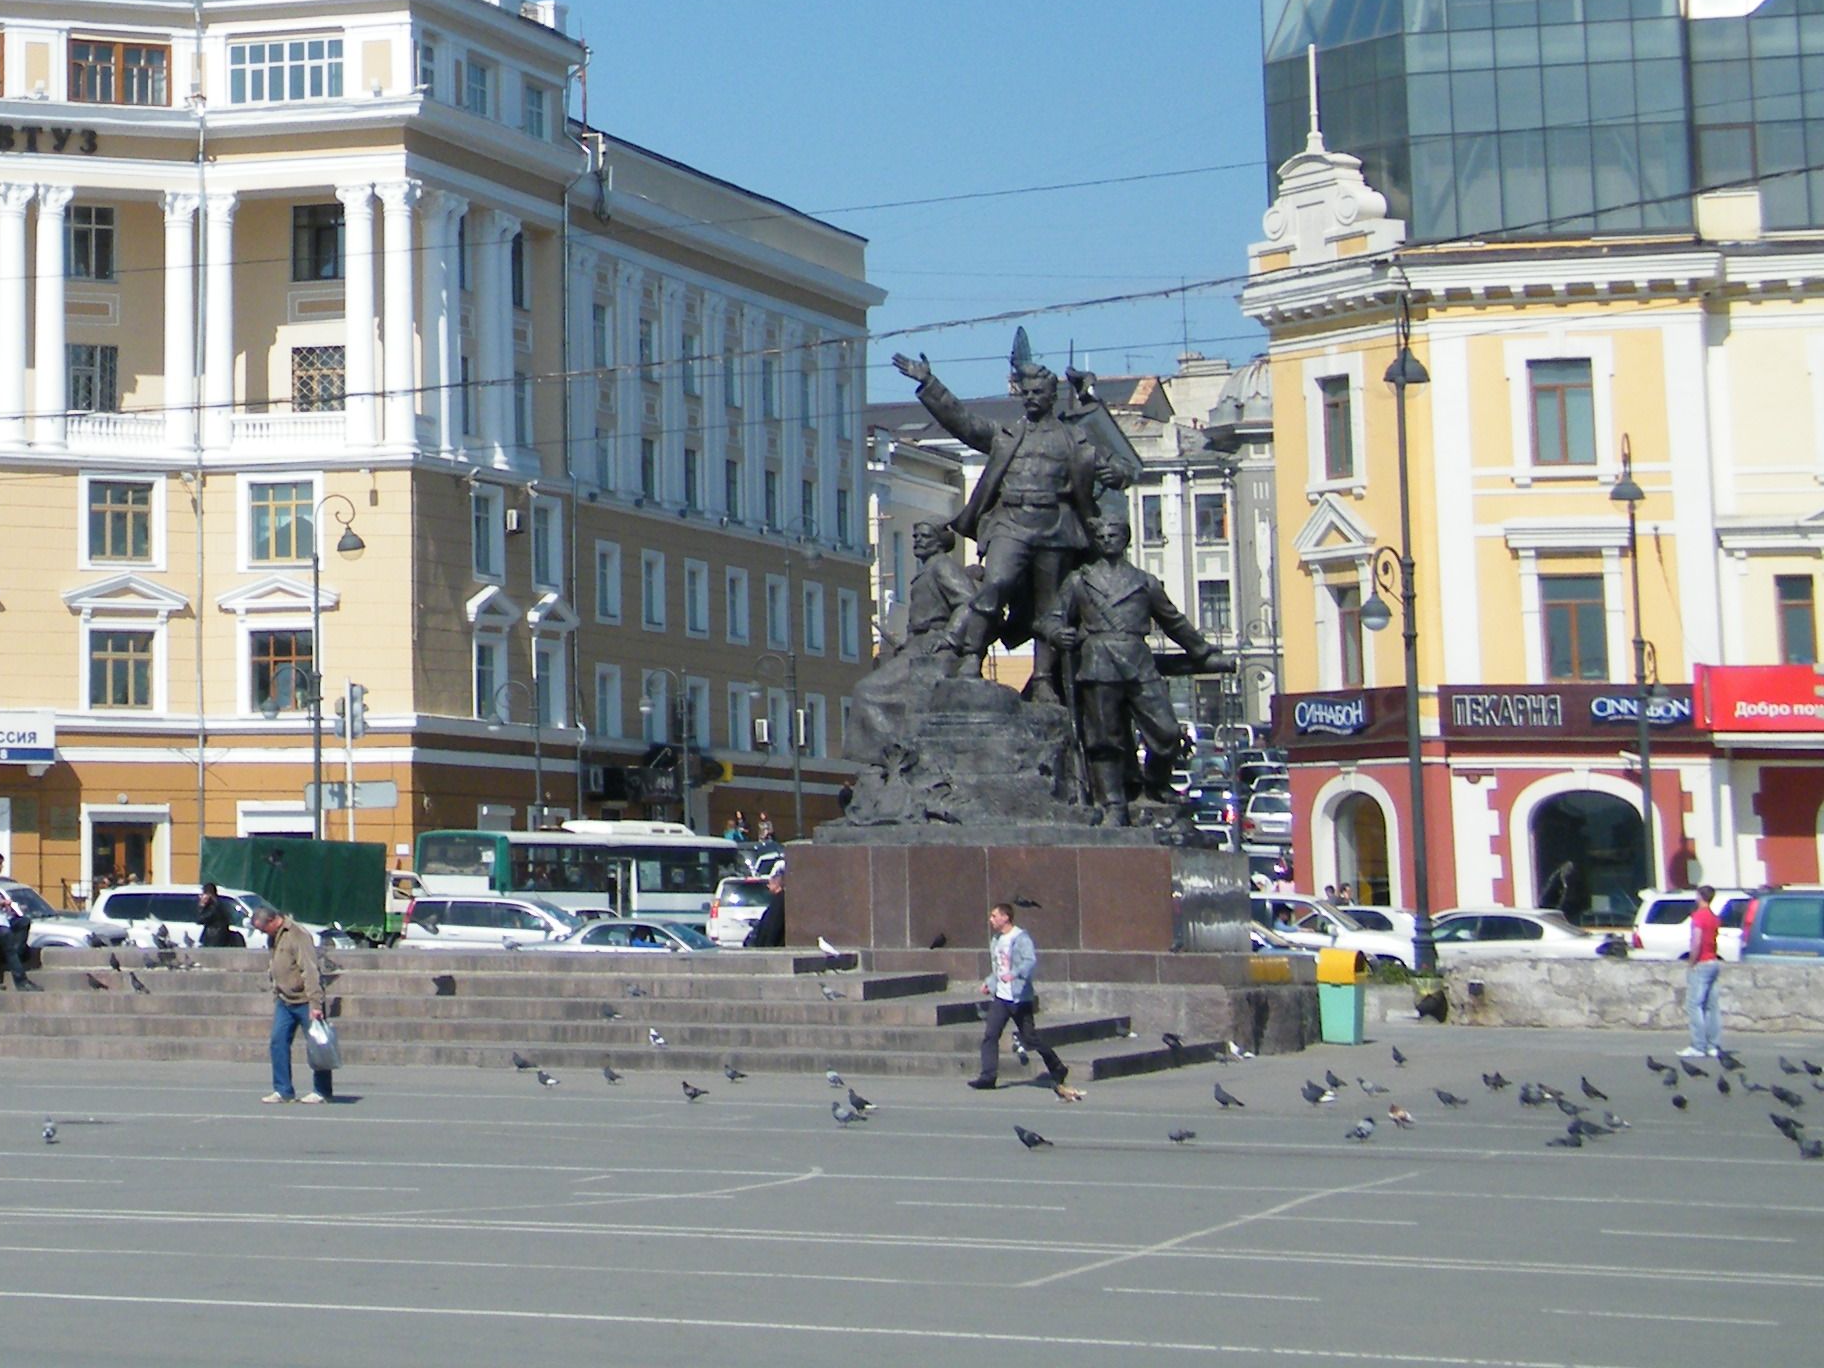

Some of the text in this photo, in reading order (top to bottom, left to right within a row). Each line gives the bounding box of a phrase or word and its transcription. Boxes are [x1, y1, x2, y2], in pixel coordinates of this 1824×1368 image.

[1295, 700, 1364, 728] СИННАБОН
[1452, 694, 1562, 726] ПЕКАРНЯ
[1591, 697, 1690, 718] CINNBON
[1734, 700, 1824, 718] Добро по
